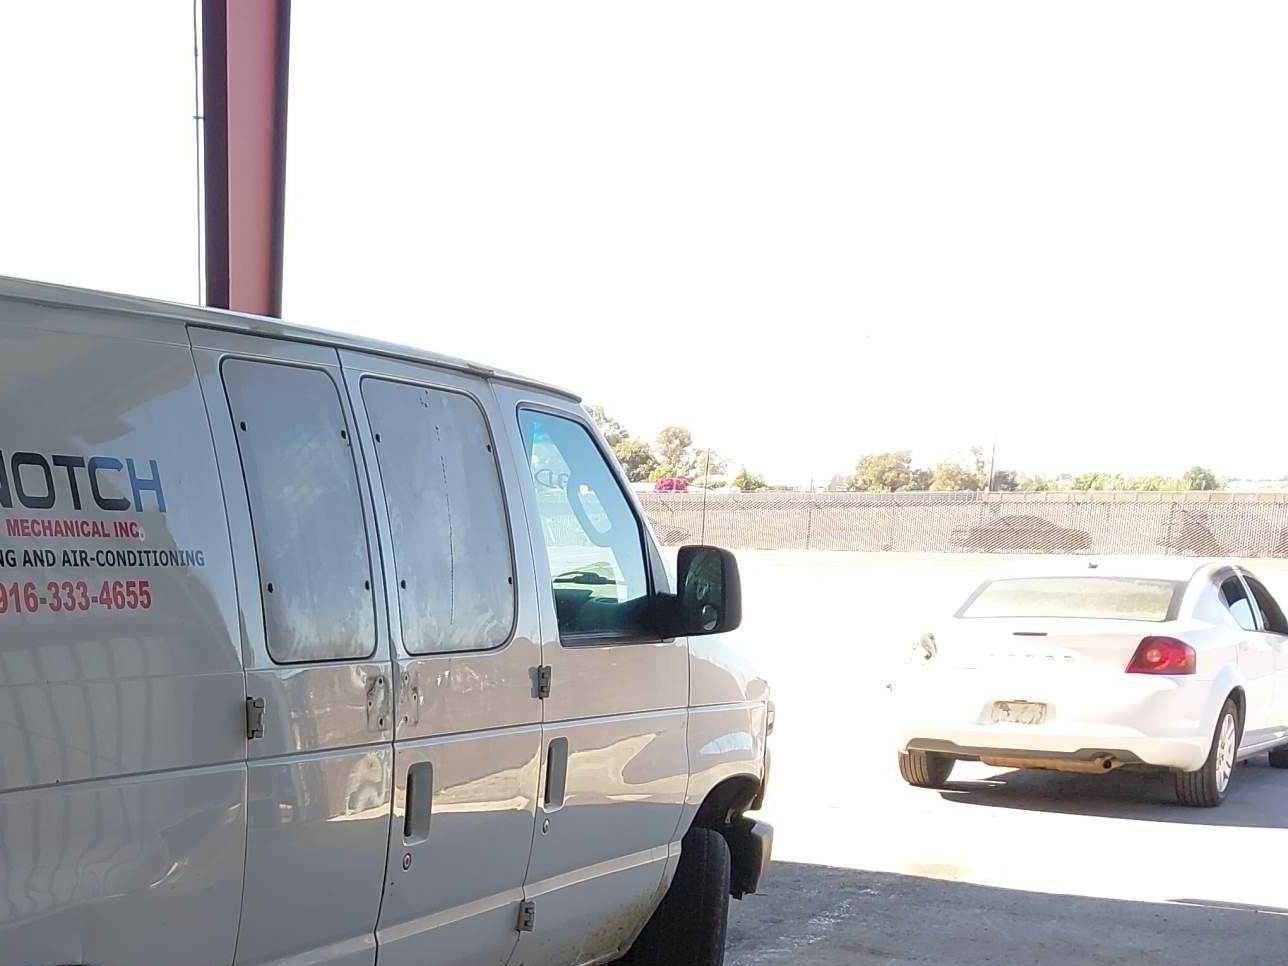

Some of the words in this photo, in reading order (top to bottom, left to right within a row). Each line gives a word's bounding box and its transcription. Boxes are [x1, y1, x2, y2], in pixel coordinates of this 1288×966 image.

[6, 519, 110, 538] MECHANICAL
[22, 549, 56, 567] AND
[62, 550, 205, 567] AIR-CONDITIONING
